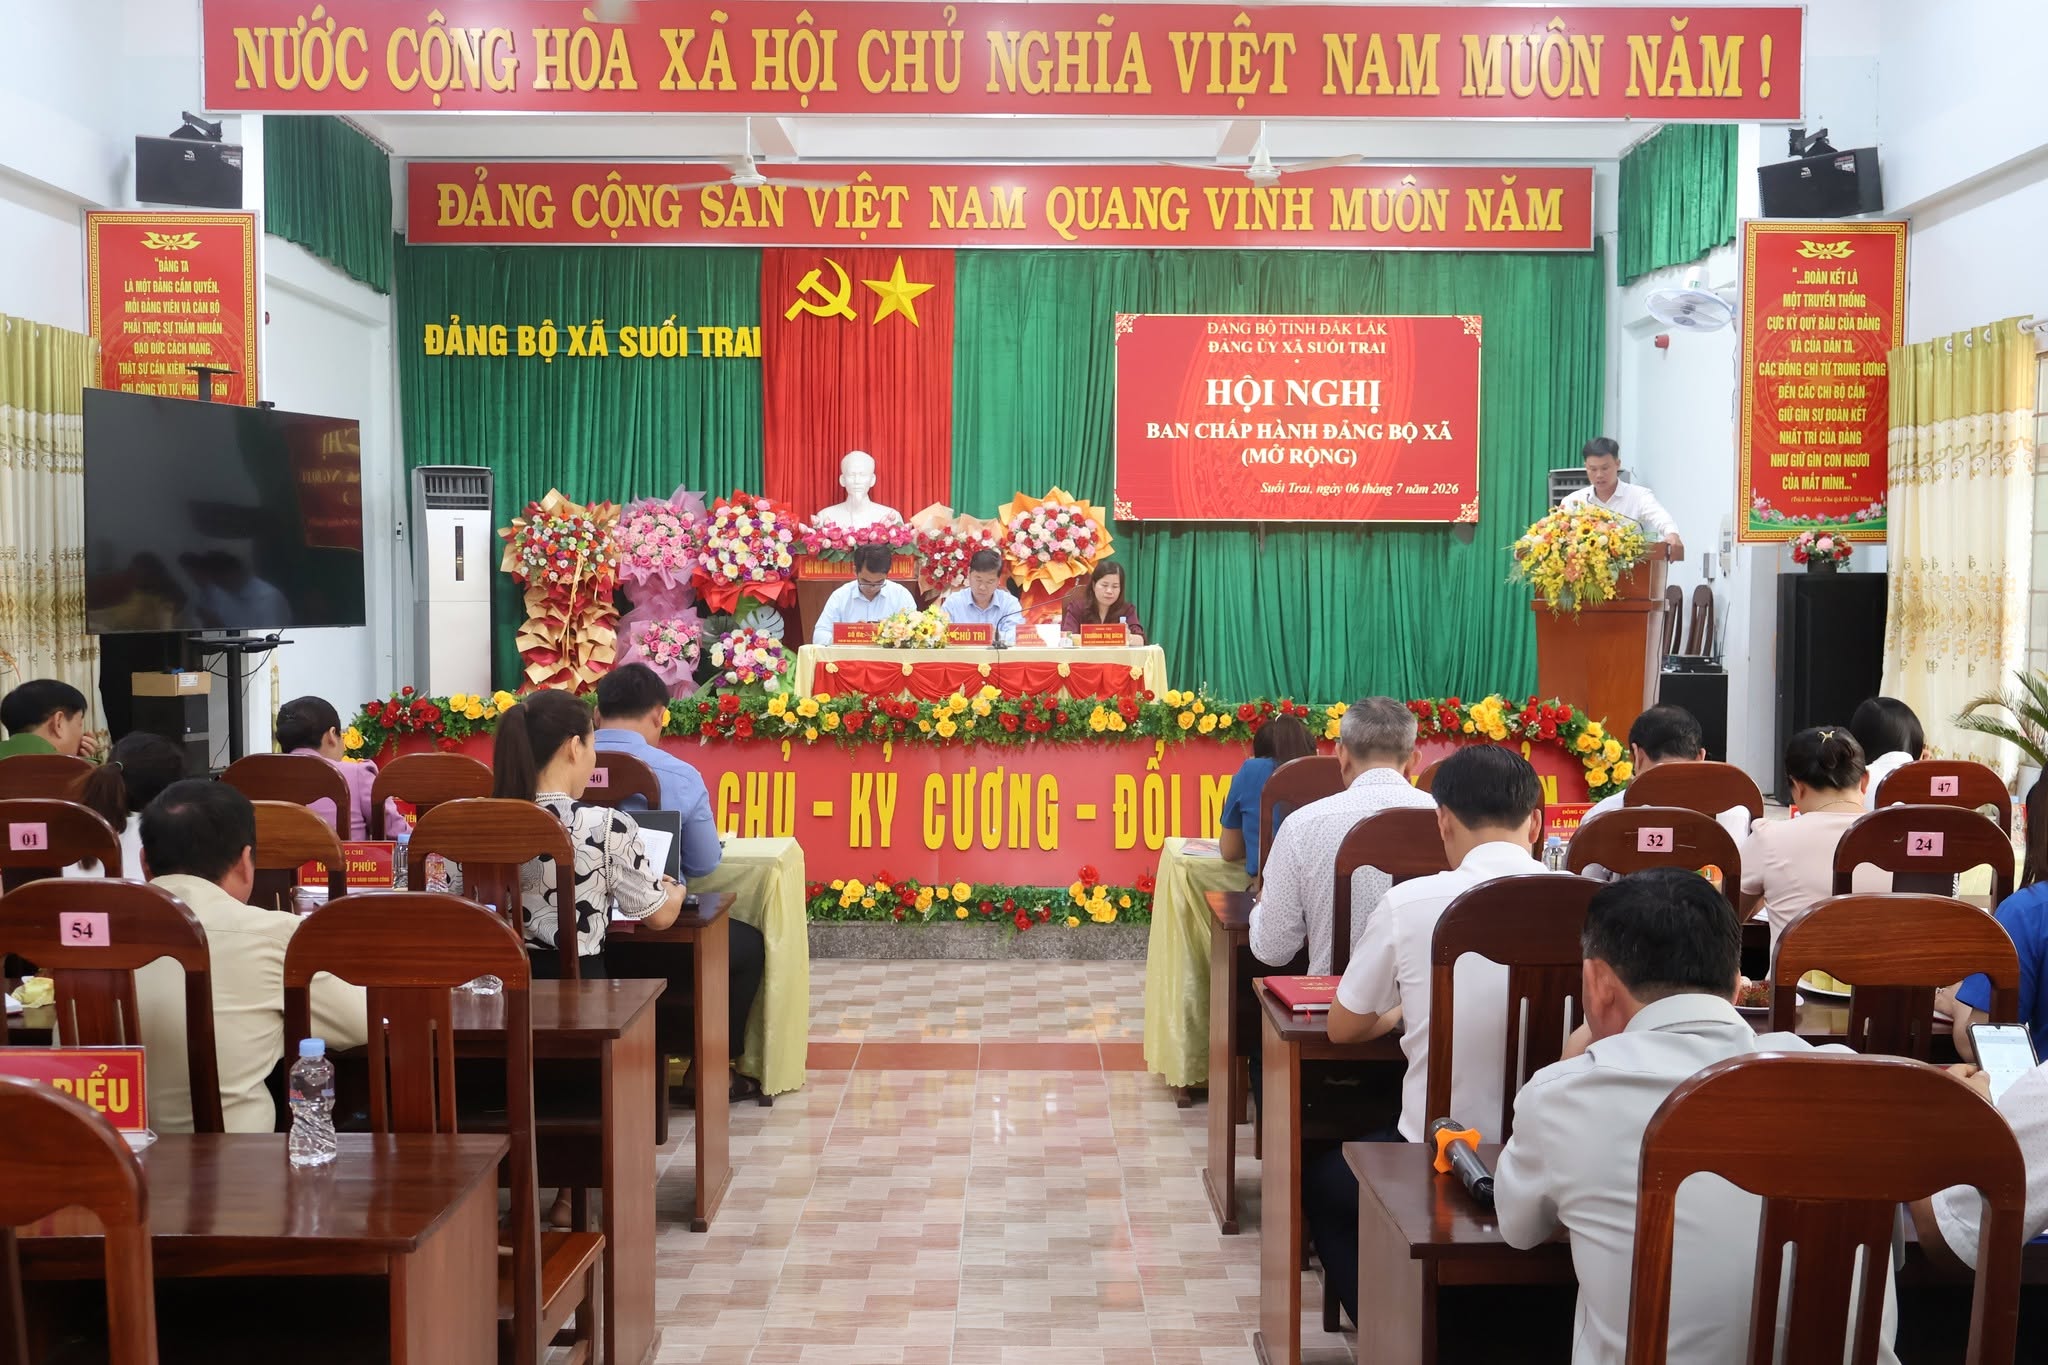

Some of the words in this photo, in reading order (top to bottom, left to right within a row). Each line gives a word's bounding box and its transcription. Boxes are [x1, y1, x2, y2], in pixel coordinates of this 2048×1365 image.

[235, 5, 369, 91] NƯỚC
[387, 11, 519, 108] CỘNG
[531, 8, 639, 91] HÒA
[658, 11, 738, 91] XÃ
[751, 9, 839, 108] HỘI
[857, 4, 962, 94] CHỦ
[985, 13, 1153, 96] NGHĨA
[1168, 12, 1298, 110] VIỆT
[1322, 33, 1441, 96] NAM
[1461, 17, 1605, 98] MUÔN
[1625, 15, 1745, 98] NĂM
[437, 166, 556, 229] ĐẢNG
[572, 170, 683, 239] CỘNG
[803, 170, 910, 240] VIỆT
[929, 186, 1027, 230] NAM
[1045, 186, 1190, 240] QUANG
[1207, 185, 1314, 232] VINH
[1329, 174, 1450, 233] MUÔN
[1465, 175, 1564, 233] NĂM
[180, 260, 189, 273] TA
[1830, 266, 1846, 285] KẾT
[1847, 268, 1858, 285] LÀ
[124, 278, 134, 293] LÀ
[135, 278, 151, 296] MỘT
[153, 276, 173, 293] ĐẢNG
[175, 277, 192, 293] CẦM
[141, 297, 161, 313] ĐẢNG
[163, 299, 180, 314] VIÊN
[181, 299, 191, 314] VÀ
[193, 299, 208, 314] CÁN
[210, 299, 220, 317] BỘ
[1783, 290, 1801, 310] MỘT
[1803, 289, 1836, 308] TRUYỀN
[1838, 289, 1866, 308] THỐNG
[123, 317, 141, 334] PHẢI
[162, 321, 174, 336] SỰ
[1208, 319, 1251, 334] ĐẢNG
[1255, 319, 1276, 337] BỘ
[1280, 319, 1315, 334] TỈNH
[1767, 315, 1784, 333] CỰC
[1818, 314, 1836, 330] BÁU
[1838, 312, 1855, 330] CỦA
[1857, 312, 1881, 330] ĐẢNG
[424, 314, 508, 357] ĐẢNG
[517, 319, 557, 364] BỘ
[567, 317, 606, 357] XÃ
[619, 313, 688, 358] SUỐI
[698, 325, 761, 358] TRAI
[1208, 338, 1253, 353] ĐẢNG
[1282, 338, 1303, 354] XÃ
[1307, 338, 1345, 354] SUỐI
[1348, 341, 1386, 354] TRAI
[1791, 336, 1802, 353] VÀ
[1804, 335, 1821, 353] CỦA
[1823, 336, 1842, 353] DÂN
[134, 342, 149, 357] ĐẠO
[167, 340, 187, 355] CÁCH
[118, 360, 136, 377] THẬT
[138, 361, 148, 377] SỰ
[1759, 359, 1776, 376] CÁC
[1778, 358, 1802, 376] ĐỒNG
[1804, 359, 1818, 376] CHÍ
[1820, 359, 1832, 376] TỪ
[1833, 362, 1861, 376] TRUNG
[1863, 361, 1886, 376] ƯƠNG
[214, 380, 228, 396] GÌN
[1205, 375, 1275, 413] HỘI
[1286, 378, 1382, 414] NGHỊ
[1778, 381, 1796, 399] ĐẾN
[1798, 382, 1815, 399] CÁC
[1817, 385, 1832, 399] CHI
[1834, 382, 1845, 402] BỘ
[1778, 405, 1794, 422] GIỮ
[1795, 405, 1810, 422] GÌN
[1812, 406, 1825, 424] SỰ
[1825, 405, 1849, 422] ĐOÀN
[1851, 404, 1867, 422] KẾT
[1146, 422, 1190, 440] BAN
[1194, 418, 1252, 440] CHẤP
[1257, 419, 1318, 440] HÀNH
[1323, 419, 1384, 440] ĐẢNG
[1388, 421, 1419, 444] BỘ
[1422, 421, 1453, 440] XÃ
[1779, 426, 1802, 445] NHẤT
[1804, 428, 1817, 445] TRÍ
[1819, 426, 1836, 445] CỦA
[1838, 426, 1862, 445] ĐẢNG
[1241, 446, 1285, 468] (MỞ
[1290, 446, 1357, 468] RỘNG)
[1770, 452, 1789, 468] NHƯ
[1790, 451, 1806, 468] GIỮ
[1807, 451, 1822, 468] GÌN
[1824, 453, 1841, 468] CON
[1260, 480, 1285, 493] Suối
[1316, 483, 1343, 496] ngày
[1345, 483, 1359, 493] 06
[1362, 483, 1393, 496] tháng
[1396, 483, 1403, 494] 7
[1405, 484, 1429, 494] năm
[1431, 483, 1459, 494] 2026
[1782, 472, 1799, 490] CỦA
[972, 630, 986, 641] TRÌ
[590, 774, 602, 784] 40
[1937, 782, 1951, 793] 47
[717, 740, 795, 838] CHỦ
[849, 741, 898, 848] KỶ
[923, 766, 1059, 851] CƯƠNG
[1113, 740, 1181, 851] ĐỔI
[1552, 817, 1561, 829] LÊ
[1563, 817, 1579, 829] VĂN
[22, 833, 38, 846] 01
[1646, 833, 1664, 848] 32
[1915, 838, 1933, 851] 24
[352, 860, 377, 873] PHÚC
[72, 922, 93, 939] 54
